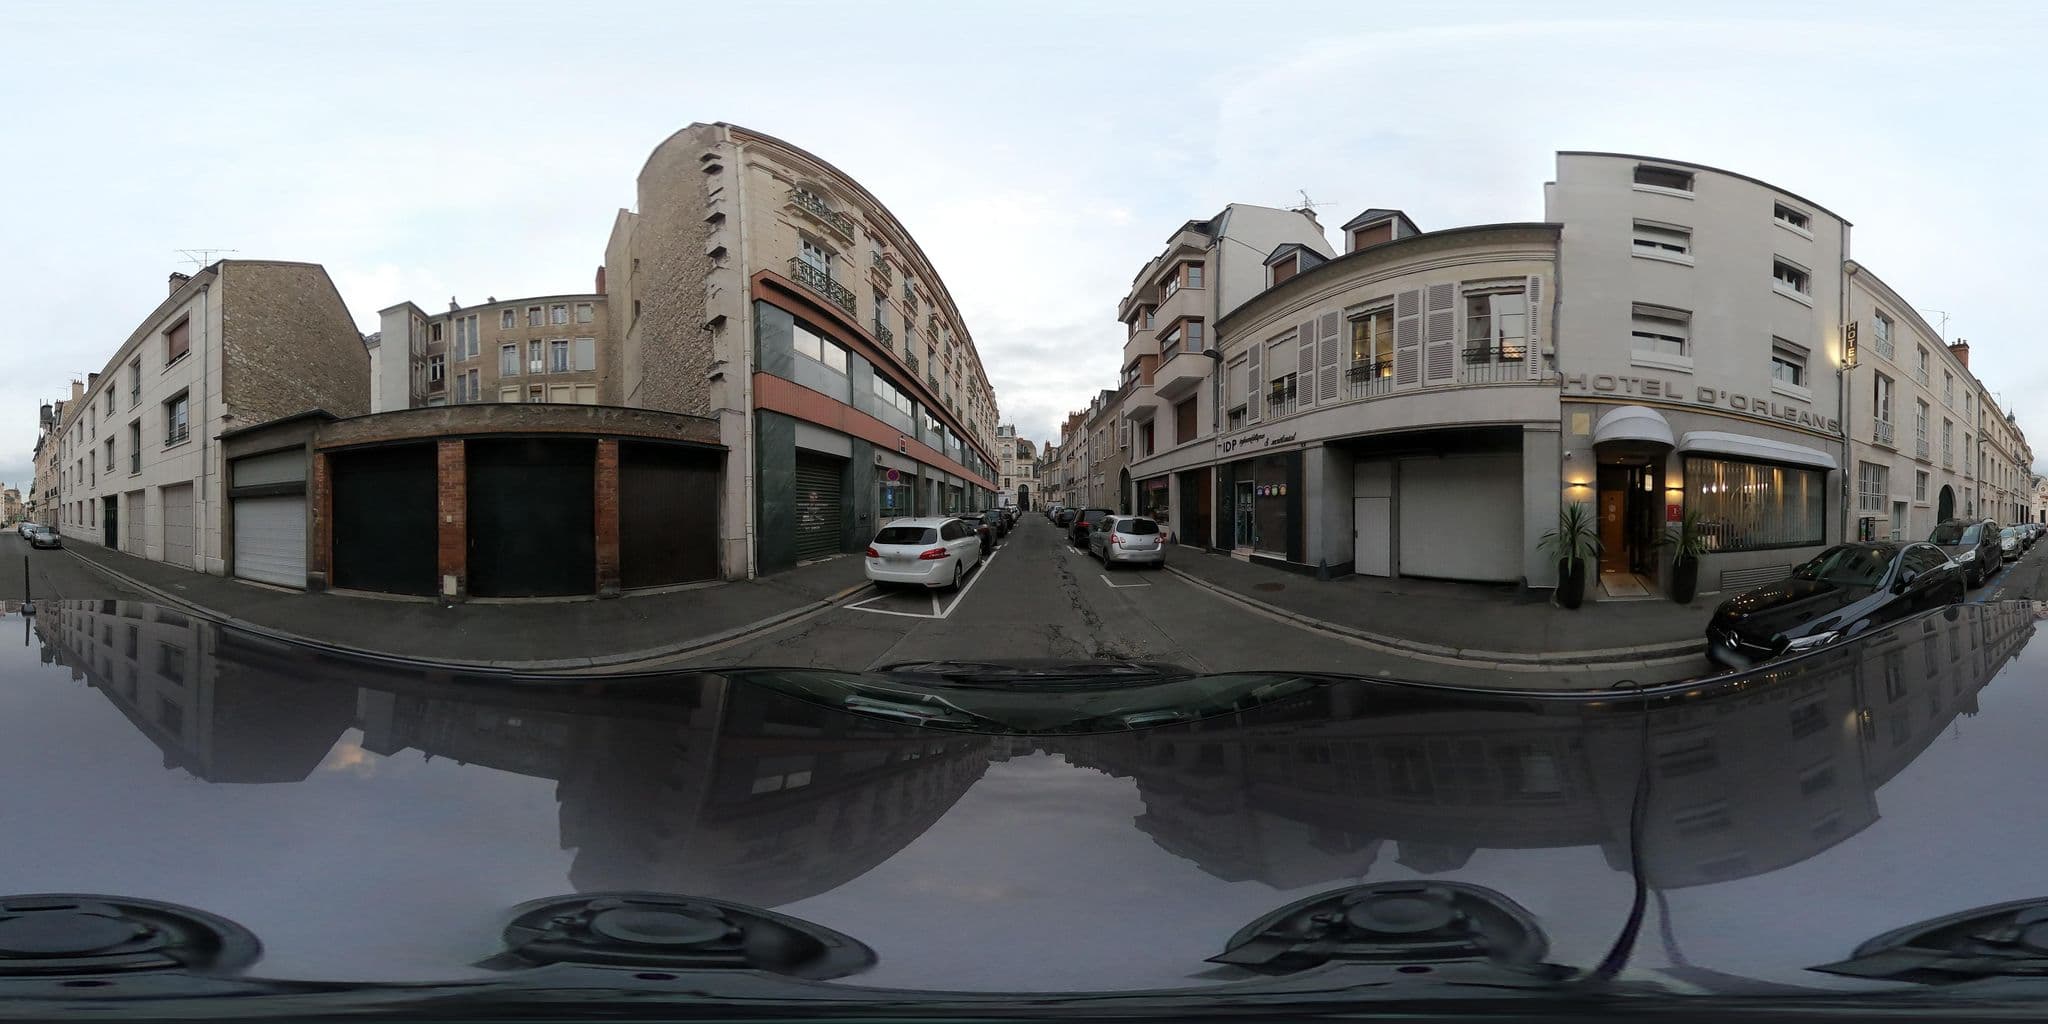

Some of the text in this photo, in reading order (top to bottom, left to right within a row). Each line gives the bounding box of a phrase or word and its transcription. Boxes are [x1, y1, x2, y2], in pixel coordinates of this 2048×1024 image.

[1848, 322, 1856, 365] HOTEL
[1563, 373, 1840, 432] HOTEL D'ORLEANS
[1223, 440, 1237, 453] IDP
